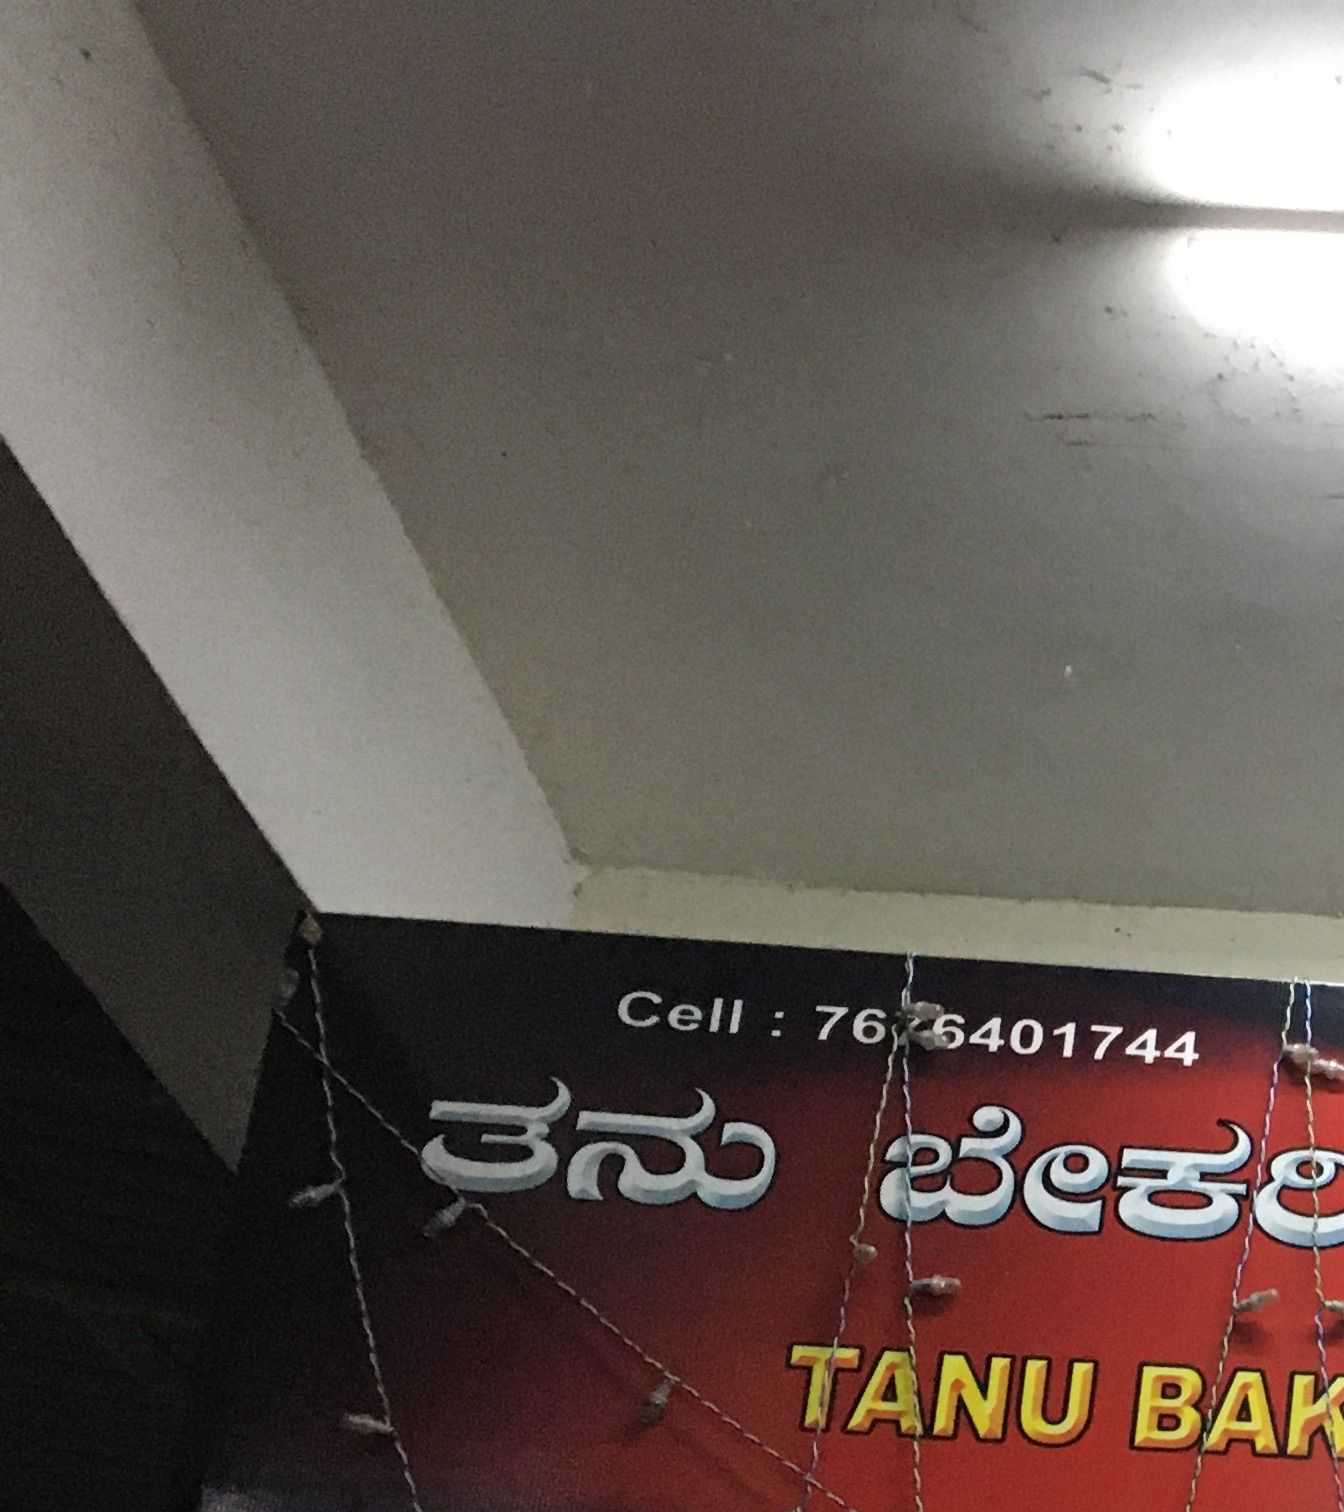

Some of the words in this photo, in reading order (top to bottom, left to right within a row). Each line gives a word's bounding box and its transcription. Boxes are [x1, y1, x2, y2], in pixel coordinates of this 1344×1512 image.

[616, 990, 743, 1035] Cell
[418, 1075, 778, 1213] ತನು
[788, 1344, 1096, 1446] TANU
